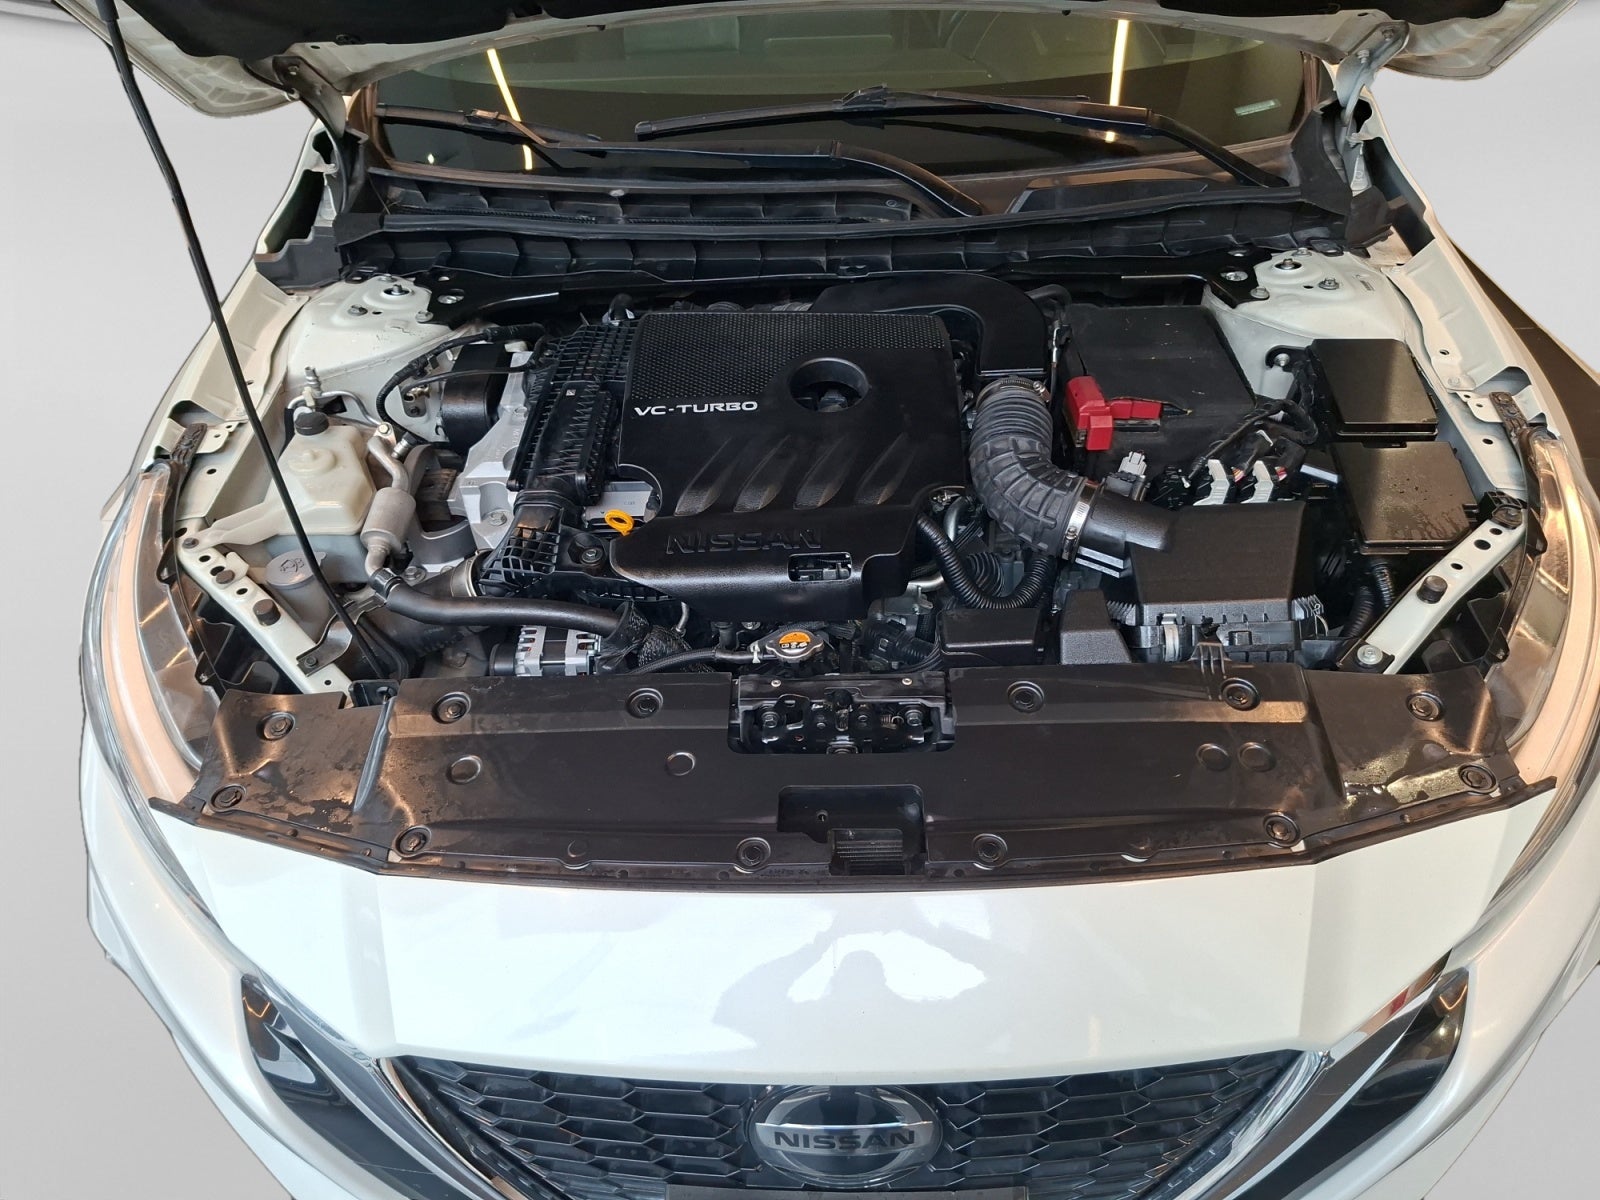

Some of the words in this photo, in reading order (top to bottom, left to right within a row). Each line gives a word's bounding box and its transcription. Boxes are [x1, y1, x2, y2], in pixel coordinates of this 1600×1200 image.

[634, 401, 758, 416] VC-TURBO
[665, 528, 822, 555] NISSAN
[774, 1130, 915, 1149] NISSAN
